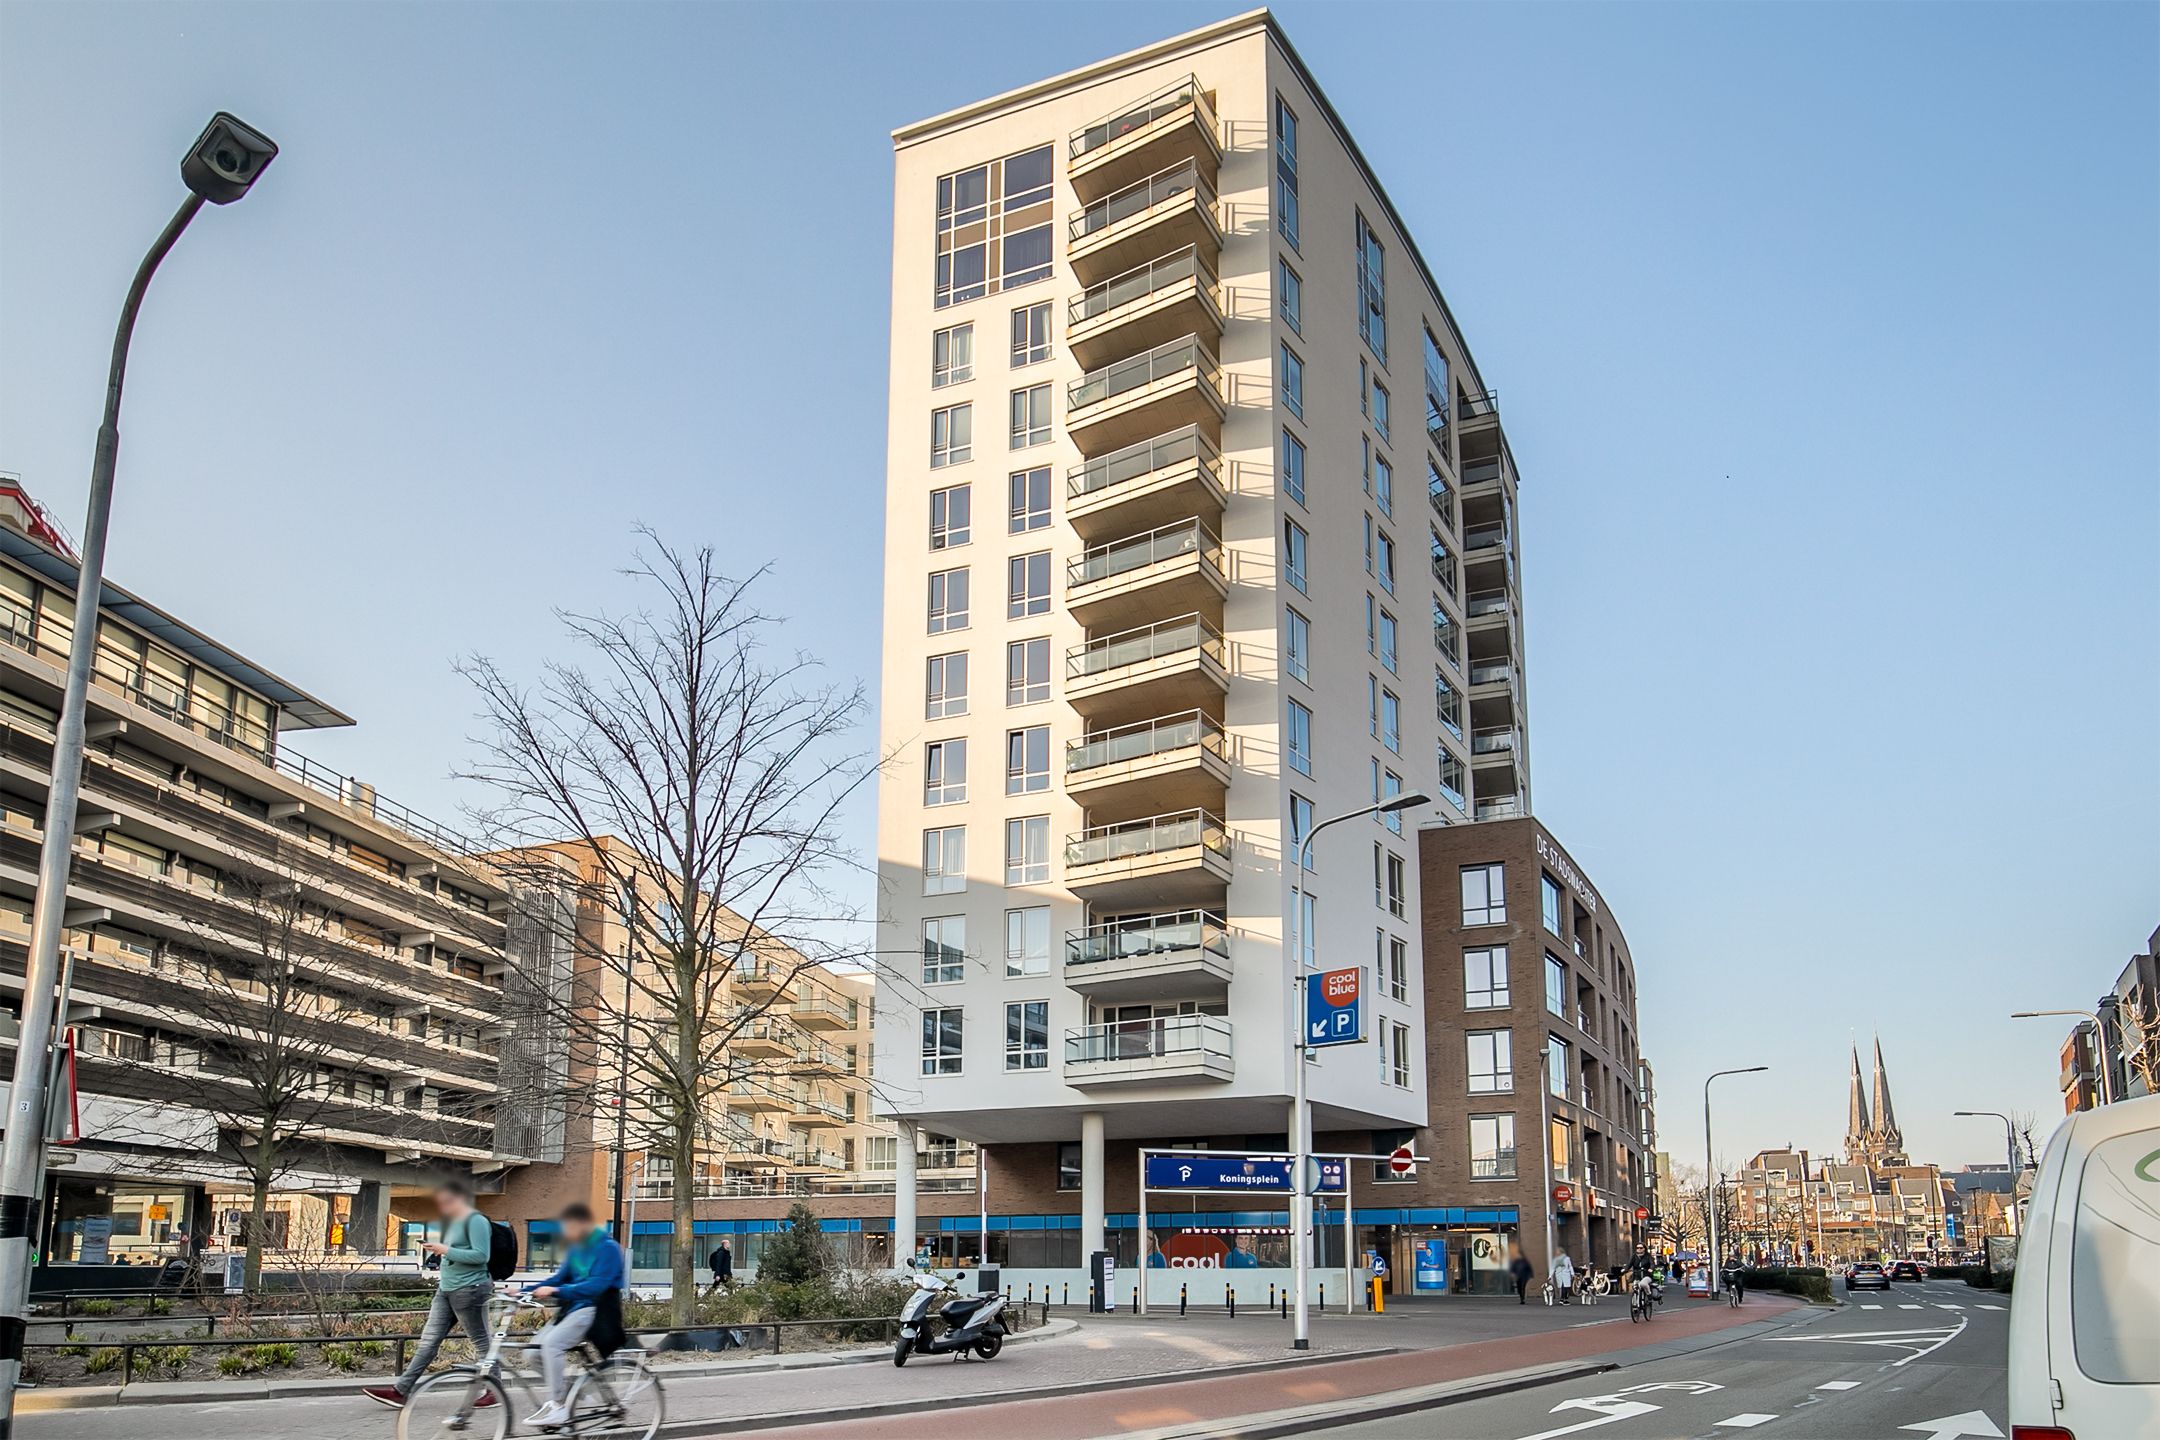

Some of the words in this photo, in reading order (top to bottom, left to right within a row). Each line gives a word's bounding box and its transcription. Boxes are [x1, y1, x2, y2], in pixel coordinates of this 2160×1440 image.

[1536, 833, 1548, 860] DE
[1328, 970, 1356, 985] cool
[1328, 983, 1356, 996] blue
[1337, 1014, 1350, 1032] P
[20, 1102, 28, 1111] 3
[1182, 1169, 1191, 1182] P
[1219, 1174, 1279, 1185] Koningsplein
[1170, 1252, 1221, 1269] cool
